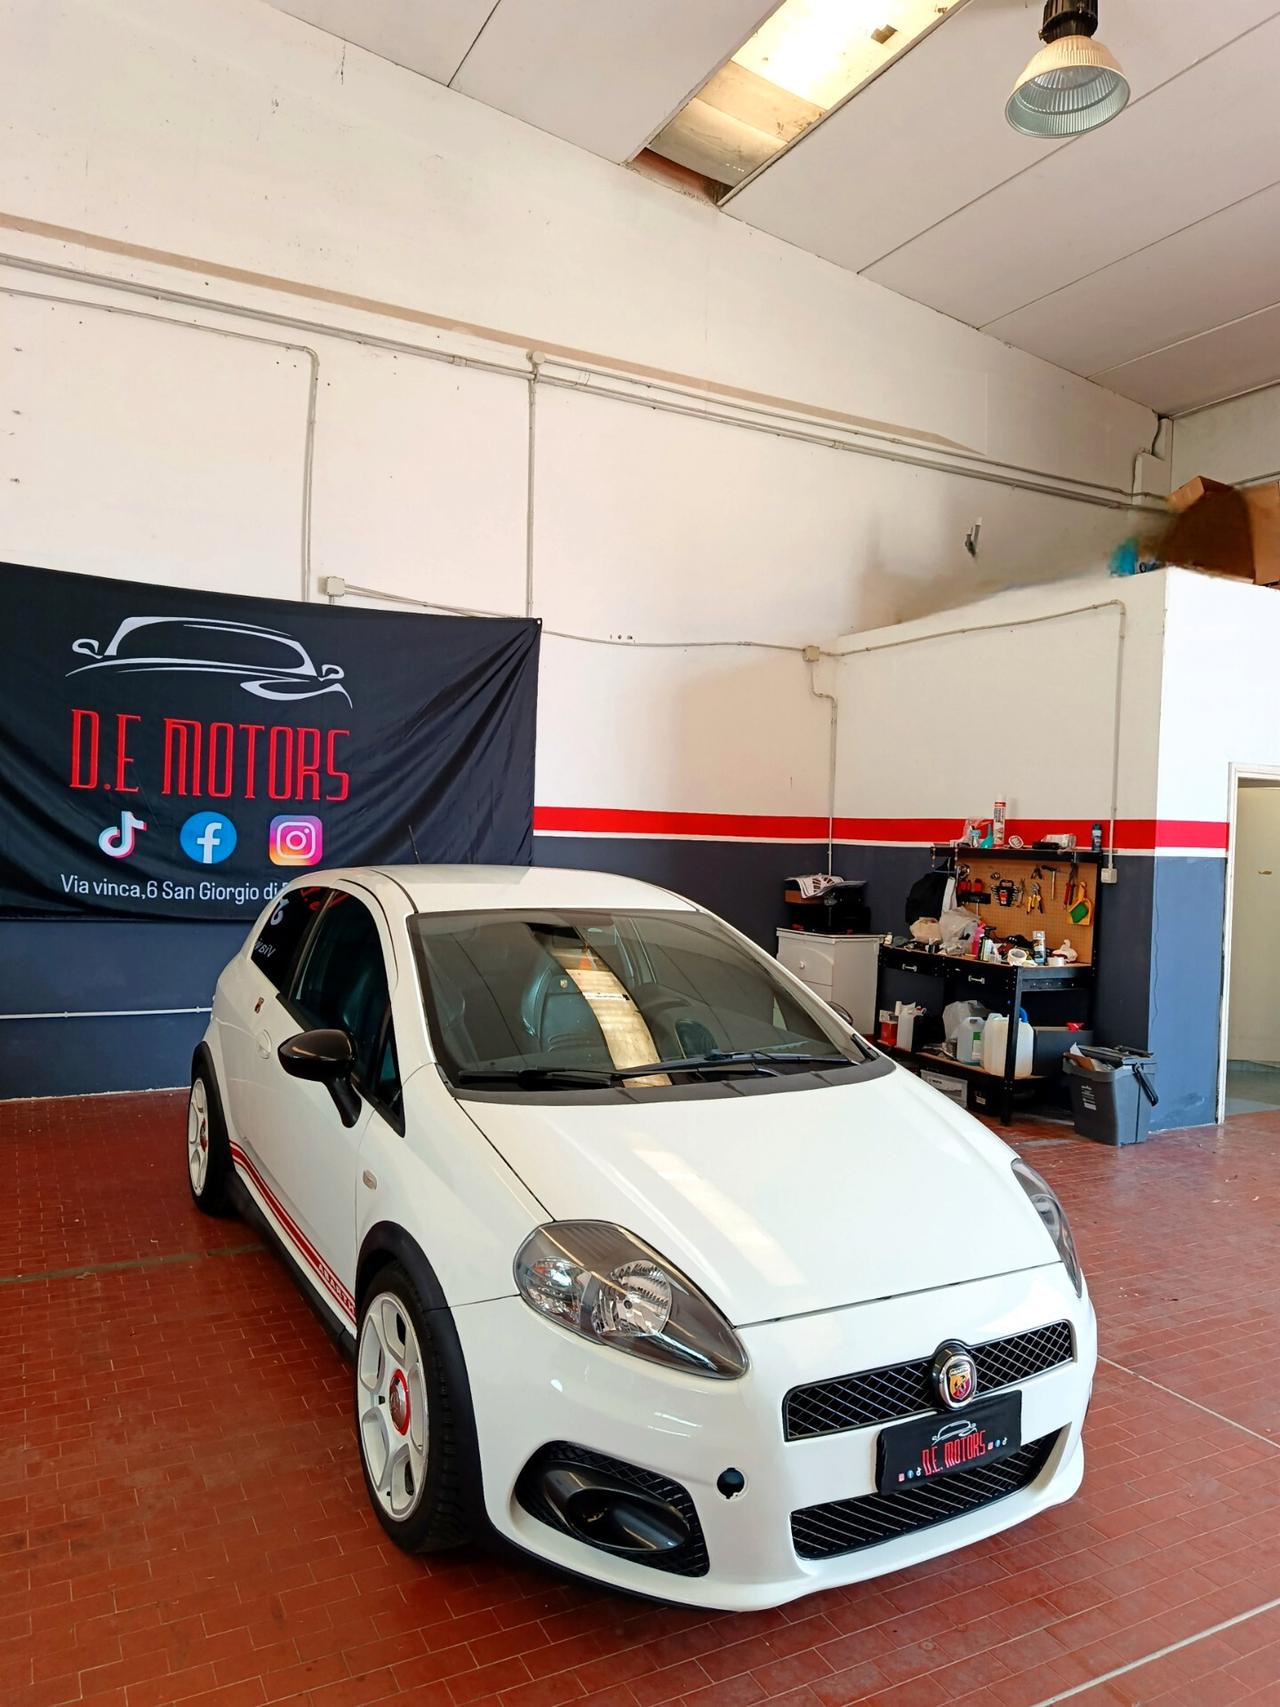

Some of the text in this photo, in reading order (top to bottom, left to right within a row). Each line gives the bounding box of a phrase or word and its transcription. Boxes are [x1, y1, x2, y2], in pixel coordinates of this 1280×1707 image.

[69, 708, 350, 801] D.E MOTORS
[60, 873, 278, 905] Via vinca,6 San Giorgio di
[944, 1430, 986, 1468] MOTORS
